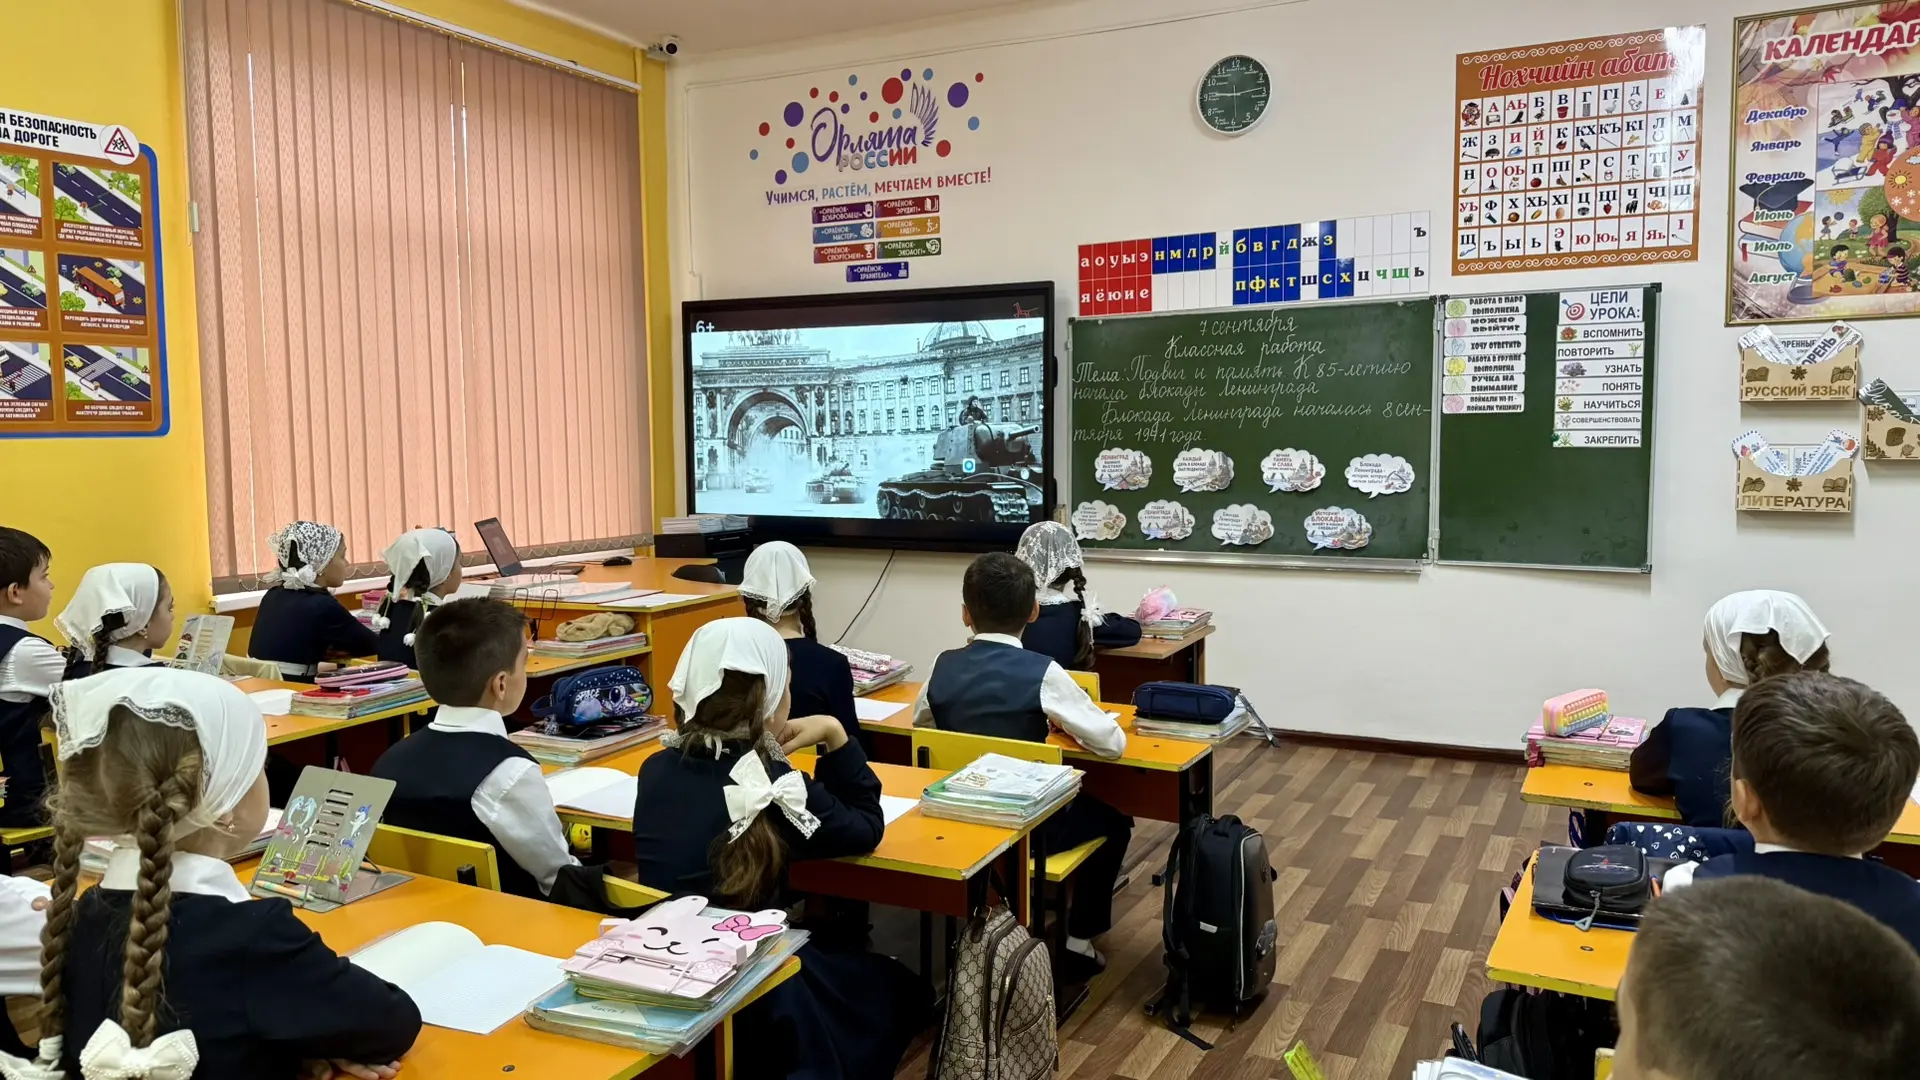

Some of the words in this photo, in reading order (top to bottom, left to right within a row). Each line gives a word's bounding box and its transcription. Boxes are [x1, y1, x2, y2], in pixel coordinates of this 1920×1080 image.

[1479, 56, 1594, 90] Нохчийн
[1488, 102, 1499, 112] А
[1534, 97, 1544, 107] Б
[1558, 94, 1568, 104] В
[1582, 91, 1592, 102] Г
[1746, 107, 1807, 123] Декабрь
[9, 113, 97, 140] БЕЗОПАСНОСТЬ
[1557, 127, 1568, 138] К
[1678, 115, 1692, 127] М
[0, 127, 11, 140] А
[14, 129, 60, 148] ДОРОГЕ
[810, 107, 917, 166] Орлята
[1751, 140, 1802, 153] Январь
[1464, 169, 1475, 180] Н
[1486, 167, 1497, 178] О
[1532, 163, 1543, 174] П
[1580, 159, 1590, 170] Р
[1603, 157, 1614, 167] С
[1628, 155, 1639, 166] Т
[822, 183, 871, 199] РАСТЁМ,
[875, 176, 932, 194] МЕЧТАЕМ
[937, 167, 991, 188] ВМЕСТЕ!
[1745, 171, 1806, 184] Февраль
[1484, 200, 1498, 210] Ф
[1509, 199, 1519, 209] Х
[1754, 211, 1793, 222] Июнь
[1080, 256, 1090, 267] а
[1094, 255, 1105, 266] о
[1109, 254, 1119, 268] у
[1122, 252, 1137, 265] ы
[1139, 251, 1149, 262] э
[1154, 250, 1165, 261] н
[1169, 247, 1182, 259] м
[1186, 246, 1197, 257] л
[1202, 244, 1214, 259] р
[1219, 240, 1229, 256] й
[1235, 237, 1246, 253] б
[1253, 241, 1264, 252] в
[1271, 239, 1280, 250] г
[1286, 238, 1298, 251] д
[1301, 235, 1318, 248] ж
[1323, 234, 1333, 245] з
[1754, 241, 1792, 252] Июль
[1750, 272, 1797, 285] Август
[1590, 291, 1628, 306] ЦЕЛИ
[1589, 307, 1641, 320] УРОКА:
[695, 320, 714, 333] 6+
[1583, 328, 1643, 338] ВСПОМНИТЬ
[1164, 335, 1246, 359] Классная
[1259, 334, 1326, 367] работа
[1558, 346, 1614, 357] ПОВТОРИТЬ
[1129, 355, 1186, 382] Подвиг
[1195, 368, 1207, 380] и
[1316, 362, 1412, 379] 85-летию
[1604, 364, 1642, 373] УЗНАТЬ
[1073, 386, 1128, 400] начала
[1602, 382, 1642, 391] ПОНЯТЬ
[1745, 384, 1806, 396] РУССКИЙ
[1810, 385, 1850, 396] ЯЗЫК
[1583, 400, 1641, 409] НАУЧИТЬСЯ
[1101, 401, 1174, 433] Блокада
[1293, 403, 1371, 417] началась
[1382, 402, 1393, 418] 8
[1135, 428, 1167, 443] 1941
[1584, 435, 1640, 445] ЗАКРЕПИТЬ
[1741, 495, 1846, 508] ЛИТЕРАТУРА
